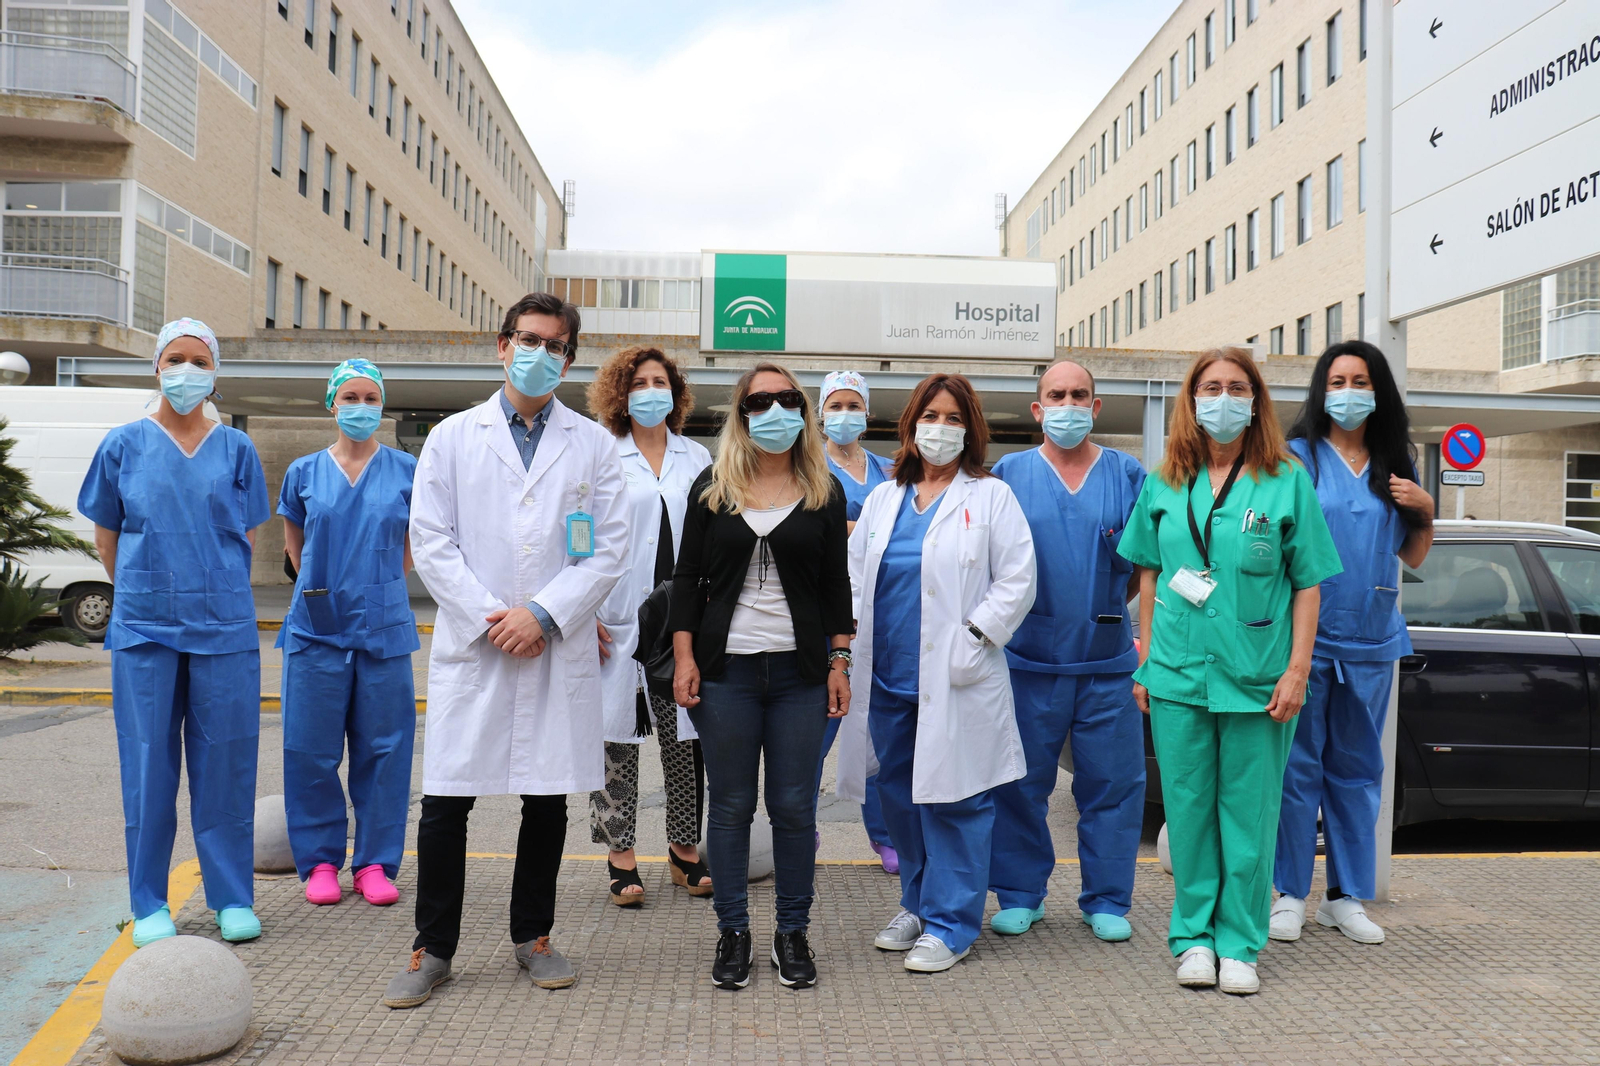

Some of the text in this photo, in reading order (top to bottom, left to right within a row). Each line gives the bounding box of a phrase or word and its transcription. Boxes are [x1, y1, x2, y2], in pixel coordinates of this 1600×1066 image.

[1489, 34, 1600, 119] ADMINISTRAC
[1486, 169, 1600, 239] SALÓN DE ACT
[954, 301, 1040, 327] Hospital
[722, 326, 740, 334] JUNTA
[741, 326, 749, 334] DE
[886, 324, 1040, 342] Juan Ramón Jiménez
[1444, 473, 1483, 482] EXCEPTO TAXIS
